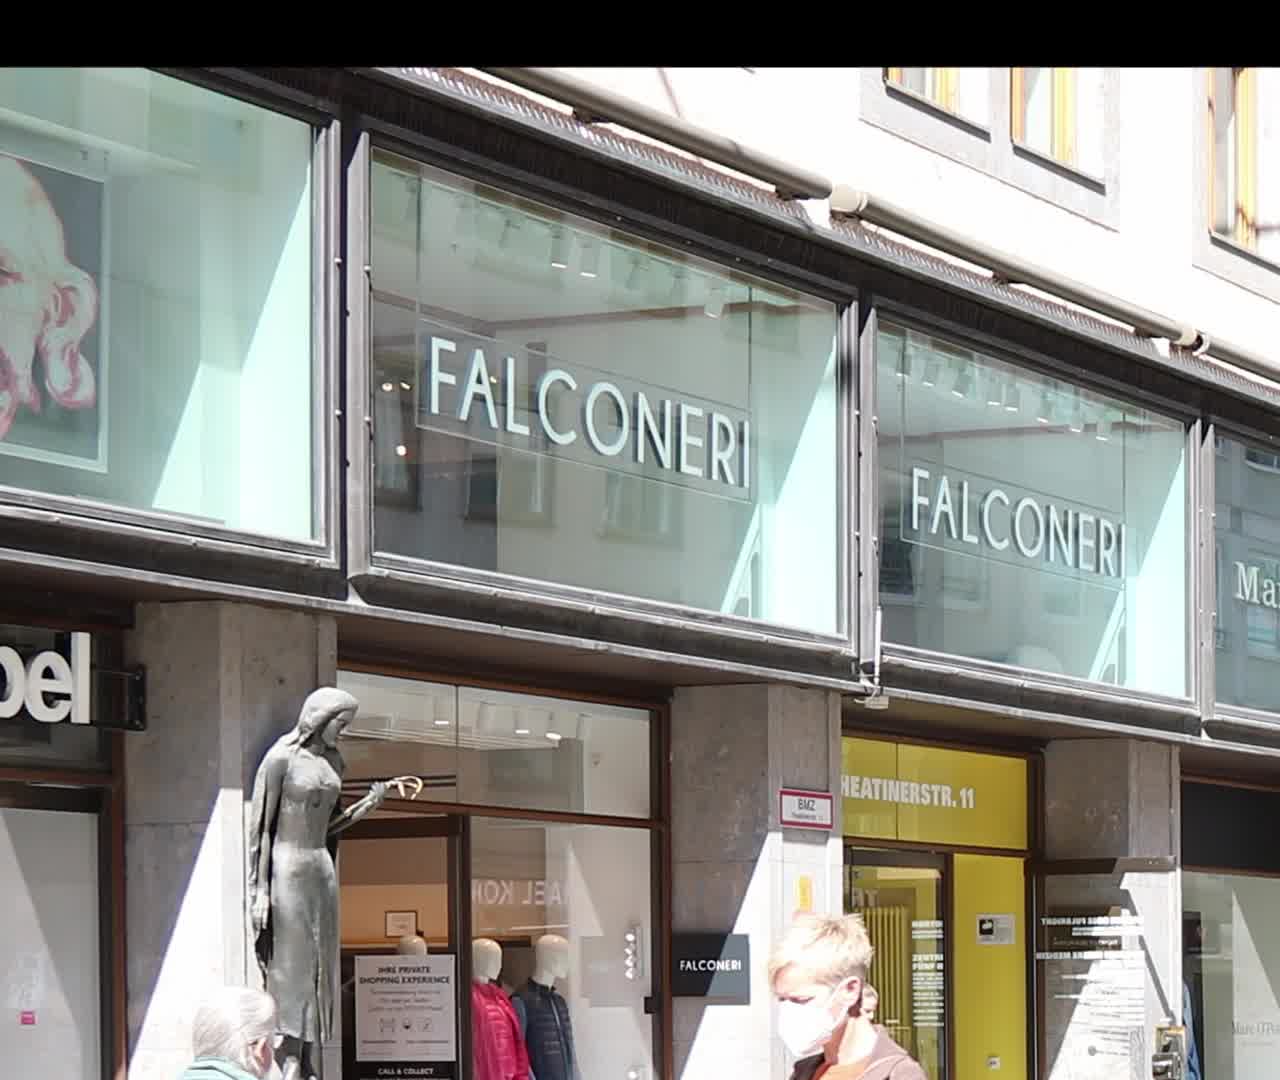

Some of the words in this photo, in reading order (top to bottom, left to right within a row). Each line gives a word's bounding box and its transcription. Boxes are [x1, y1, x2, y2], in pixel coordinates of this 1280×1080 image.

[430, 336, 750, 488] FALCONERI
[911, 466, 1126, 579] FALCONERI
[840, 774, 957, 808] HEATINERSTR.
[959, 787, 975, 809] 11
[402, 976, 450, 985] EXPERIENCE
[679, 959, 742, 971] FALCONERI
